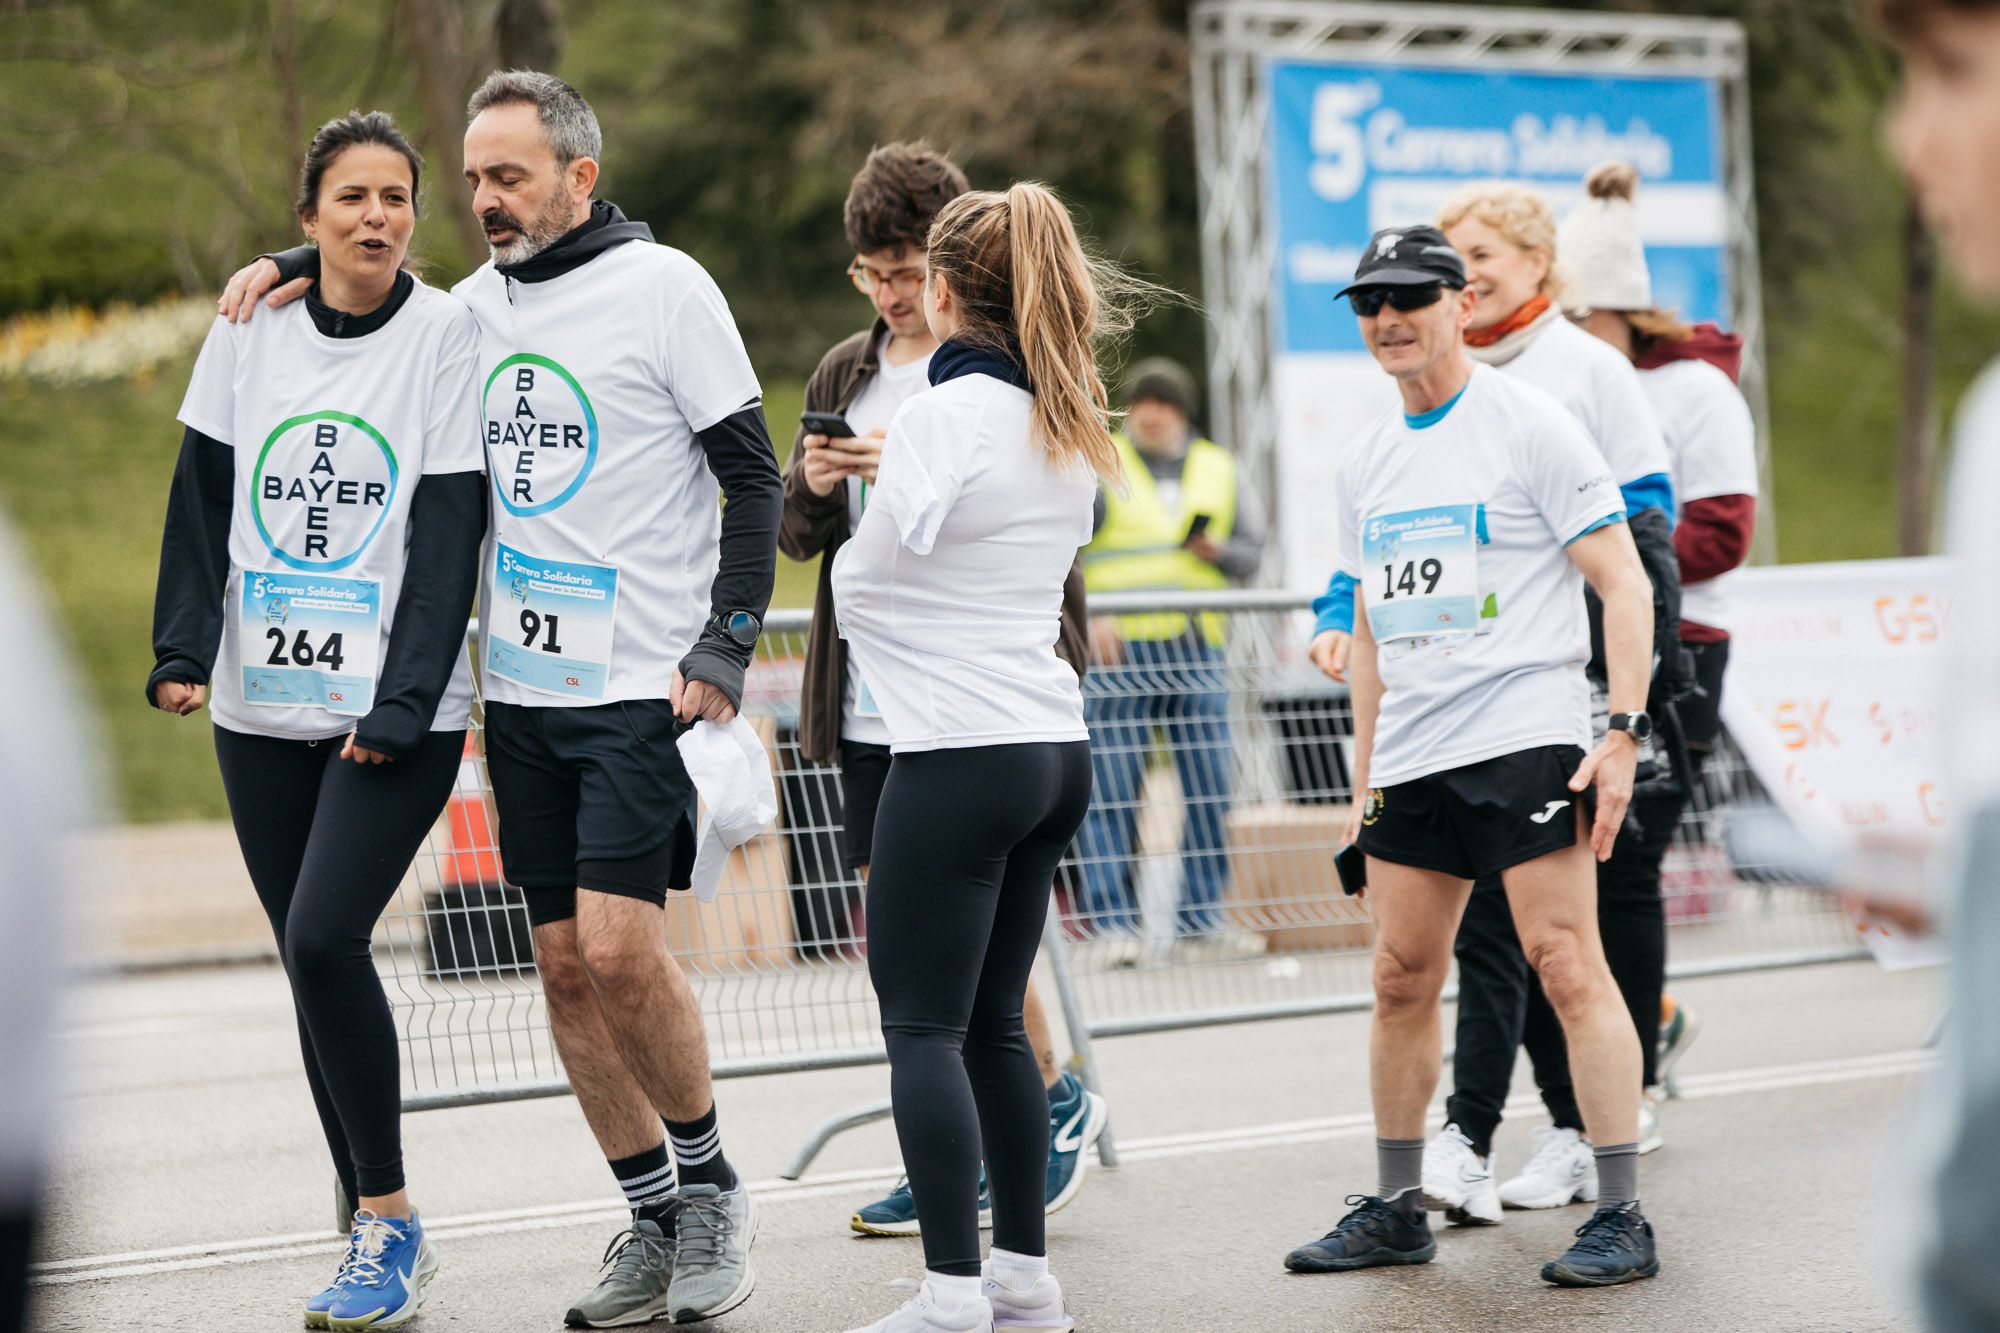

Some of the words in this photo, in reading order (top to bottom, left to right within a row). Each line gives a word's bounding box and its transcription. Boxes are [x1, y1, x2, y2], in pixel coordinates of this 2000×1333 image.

[488, 420, 585, 449] BAYER
[515, 368, 536, 503] BAYER
[263, 475, 386, 506] BAYER
[304, 423, 338, 559] BAYER
[512, 560, 540, 578] Carrera
[543, 570, 592, 585] Solidaria
[1383, 558, 1442, 600] 149
[267, 583, 304, 596] Carrera
[307, 586, 356, 599] Solidaria
[520, 608, 562, 654] 91
[266, 627, 344, 671] 264
[330, 692, 344, 701] CSL
[566, 676, 580, 687] CSL
